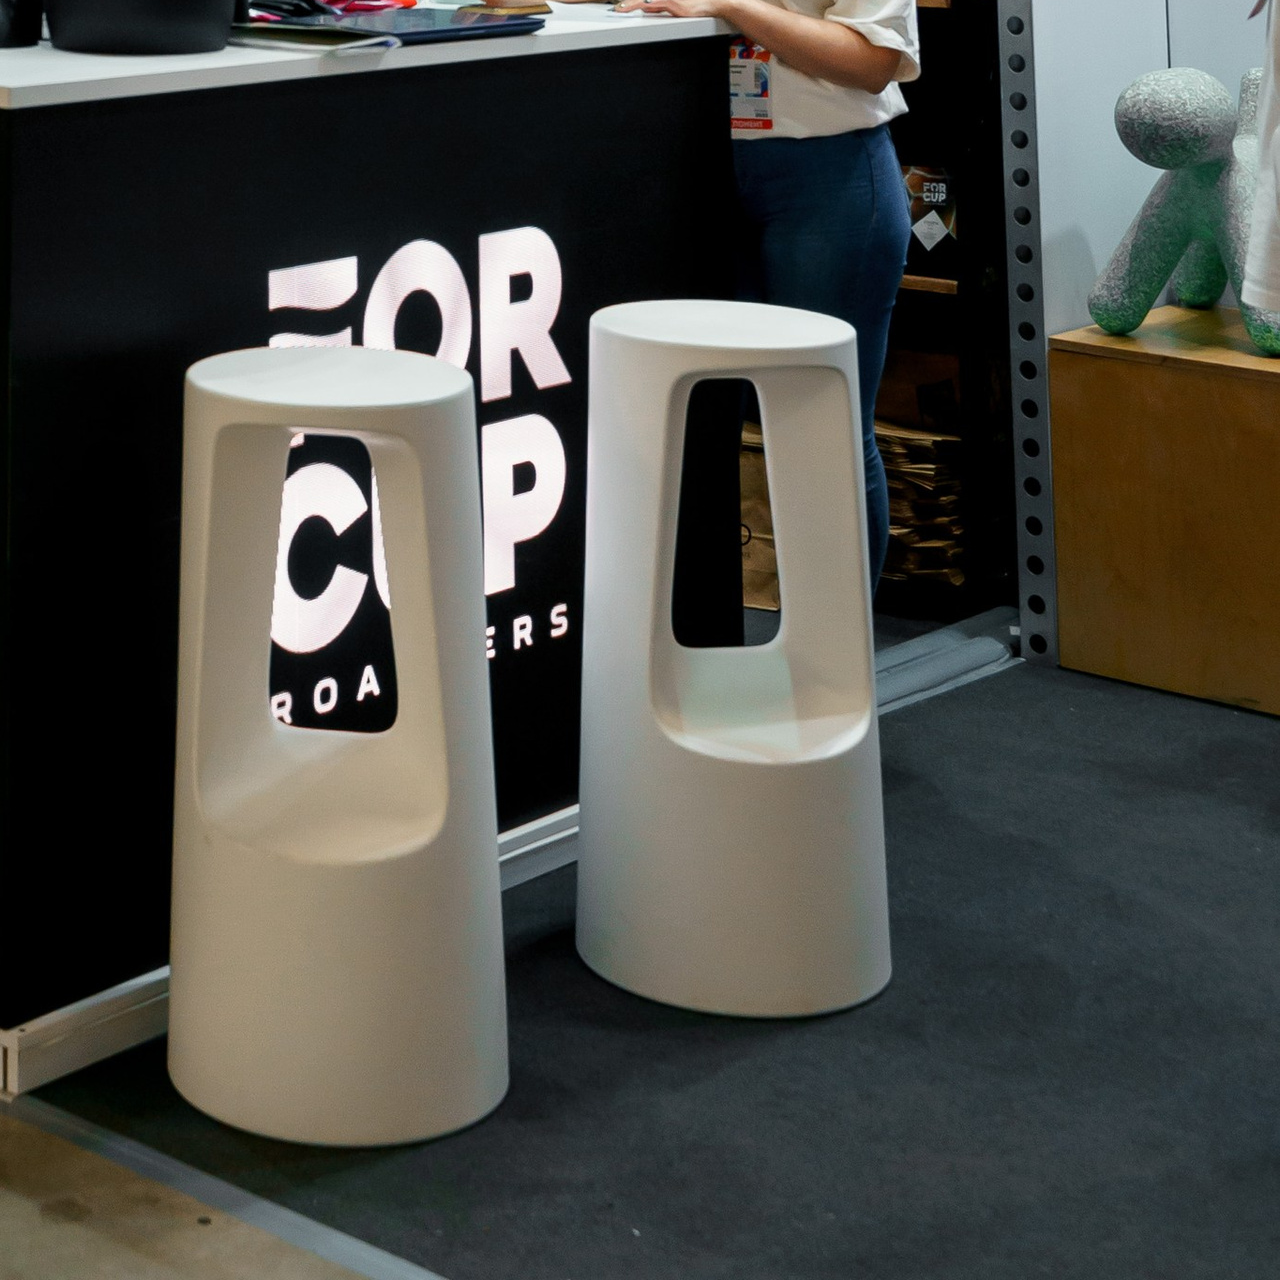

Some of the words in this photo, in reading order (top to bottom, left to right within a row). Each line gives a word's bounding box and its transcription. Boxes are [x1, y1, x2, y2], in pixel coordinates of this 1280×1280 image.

[923, 182, 946, 192] FOR
[922, 192, 946, 202] CUP
[270, 414, 567, 654] CP
